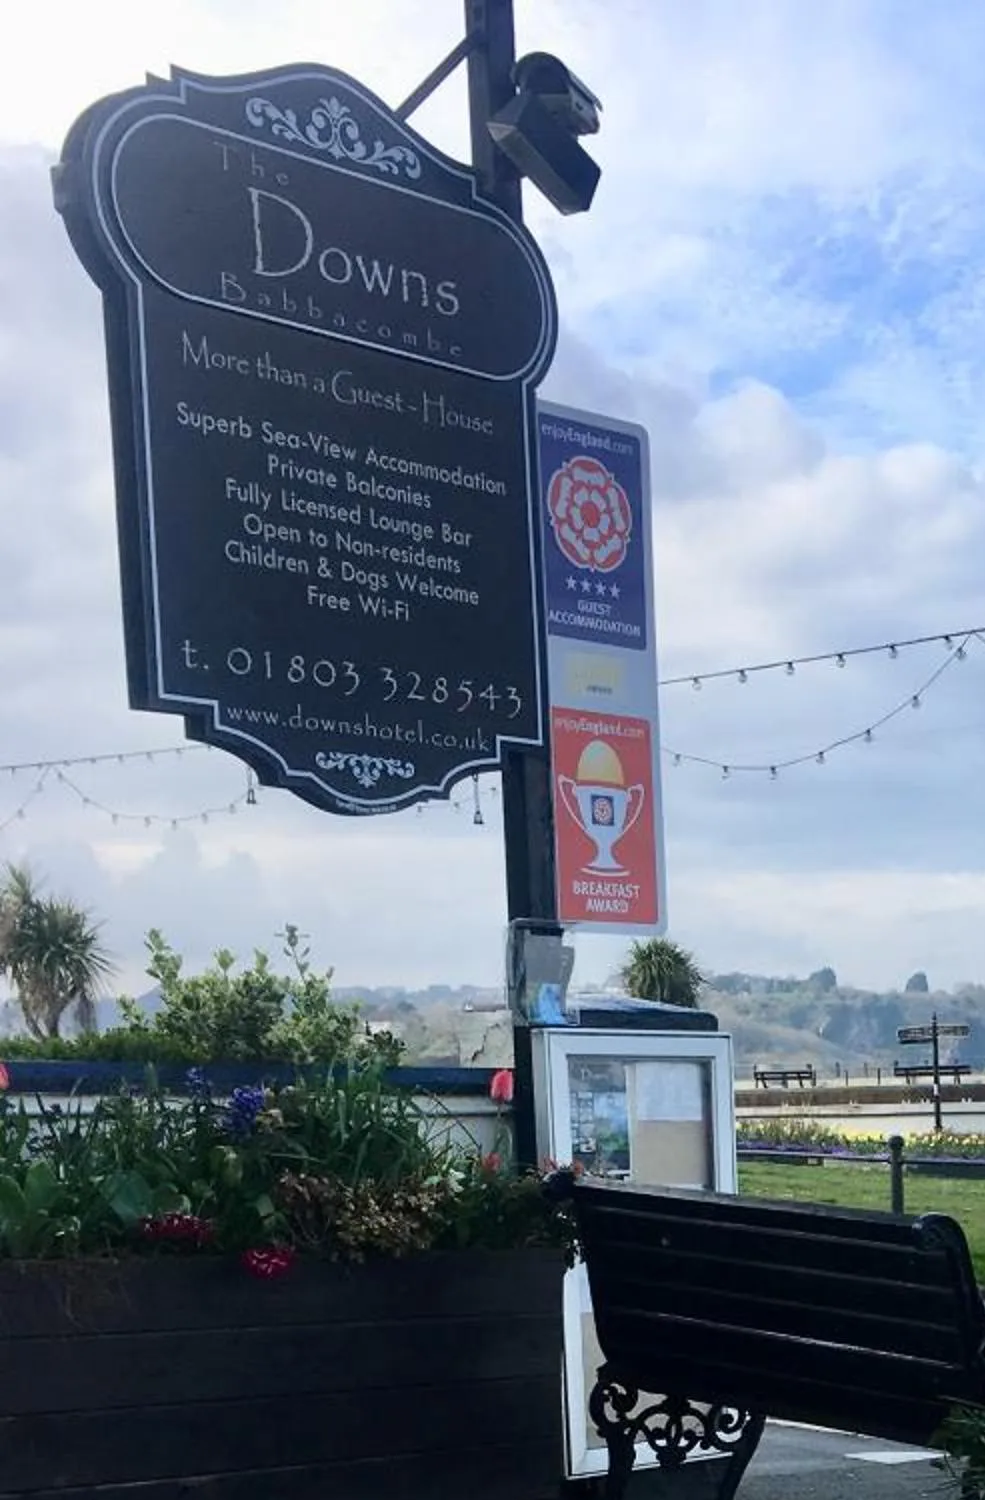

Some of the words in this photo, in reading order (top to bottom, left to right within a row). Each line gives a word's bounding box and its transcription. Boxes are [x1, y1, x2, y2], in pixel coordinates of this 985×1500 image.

[213, 141, 290, 187] The
[248, 186, 460, 316] Downs
[220, 271, 463, 357] Babbacombe
[180, 329, 250, 374] More
[256, 351, 308, 389] than
[313, 379, 326, 394] a
[176, 401, 252, 438] Superb
[260, 420, 357, 461] Sea-View
[364, 446, 507, 496] Accommodation
[541, 422, 634, 456] enjoyEngland.com
[267, 453, 338, 489] Private
[345, 470, 432, 509] Balconies
[225, 477, 273, 511] Fully
[281, 487, 362, 526] Licensed
[369, 506, 435, 543] Lounge
[441, 522, 474, 548] Bar
[243, 512, 302, 544] Open
[308, 526, 329, 548] to
[335, 529, 463, 574] Non-residents
[224, 539, 309, 576] Children
[316, 556, 334, 580] &
[340, 561, 390, 593] Dogs
[395, 571, 480, 606] Welcome
[307, 585, 351, 612] Free
[358, 594, 410, 621] Wi-Fi
[550, 609, 641, 637] ACCOMMODATION
[577, 599, 612, 616] GUEST
[226, 647, 360, 696] 01803
[380, 667, 523, 719] 328543
[227, 704, 491, 753] www.downshotel.co.uk
[572, 880, 640, 899] BREAKFAST
[585, 898, 629, 913] AWARD
